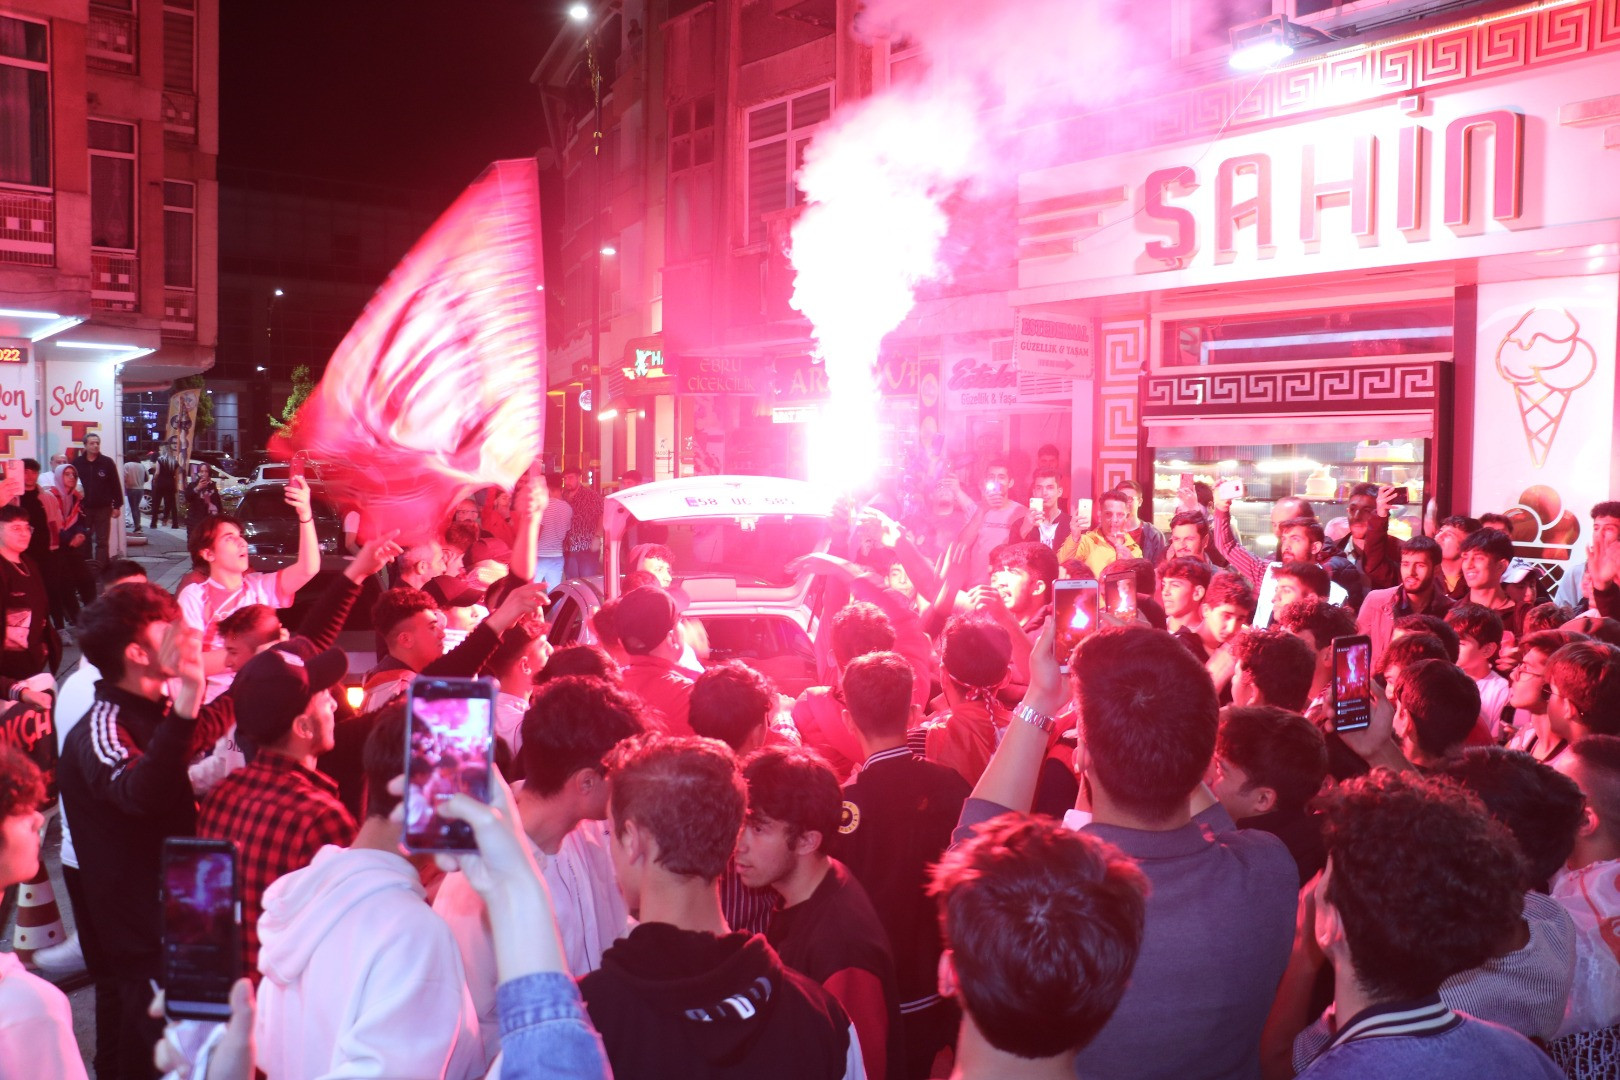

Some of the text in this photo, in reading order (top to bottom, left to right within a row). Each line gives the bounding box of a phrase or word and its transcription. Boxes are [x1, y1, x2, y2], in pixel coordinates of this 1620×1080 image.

[699, 358, 742, 374] EBRU
[50, 380, 103, 416] Salon
[698, 497, 718, 506] 58
